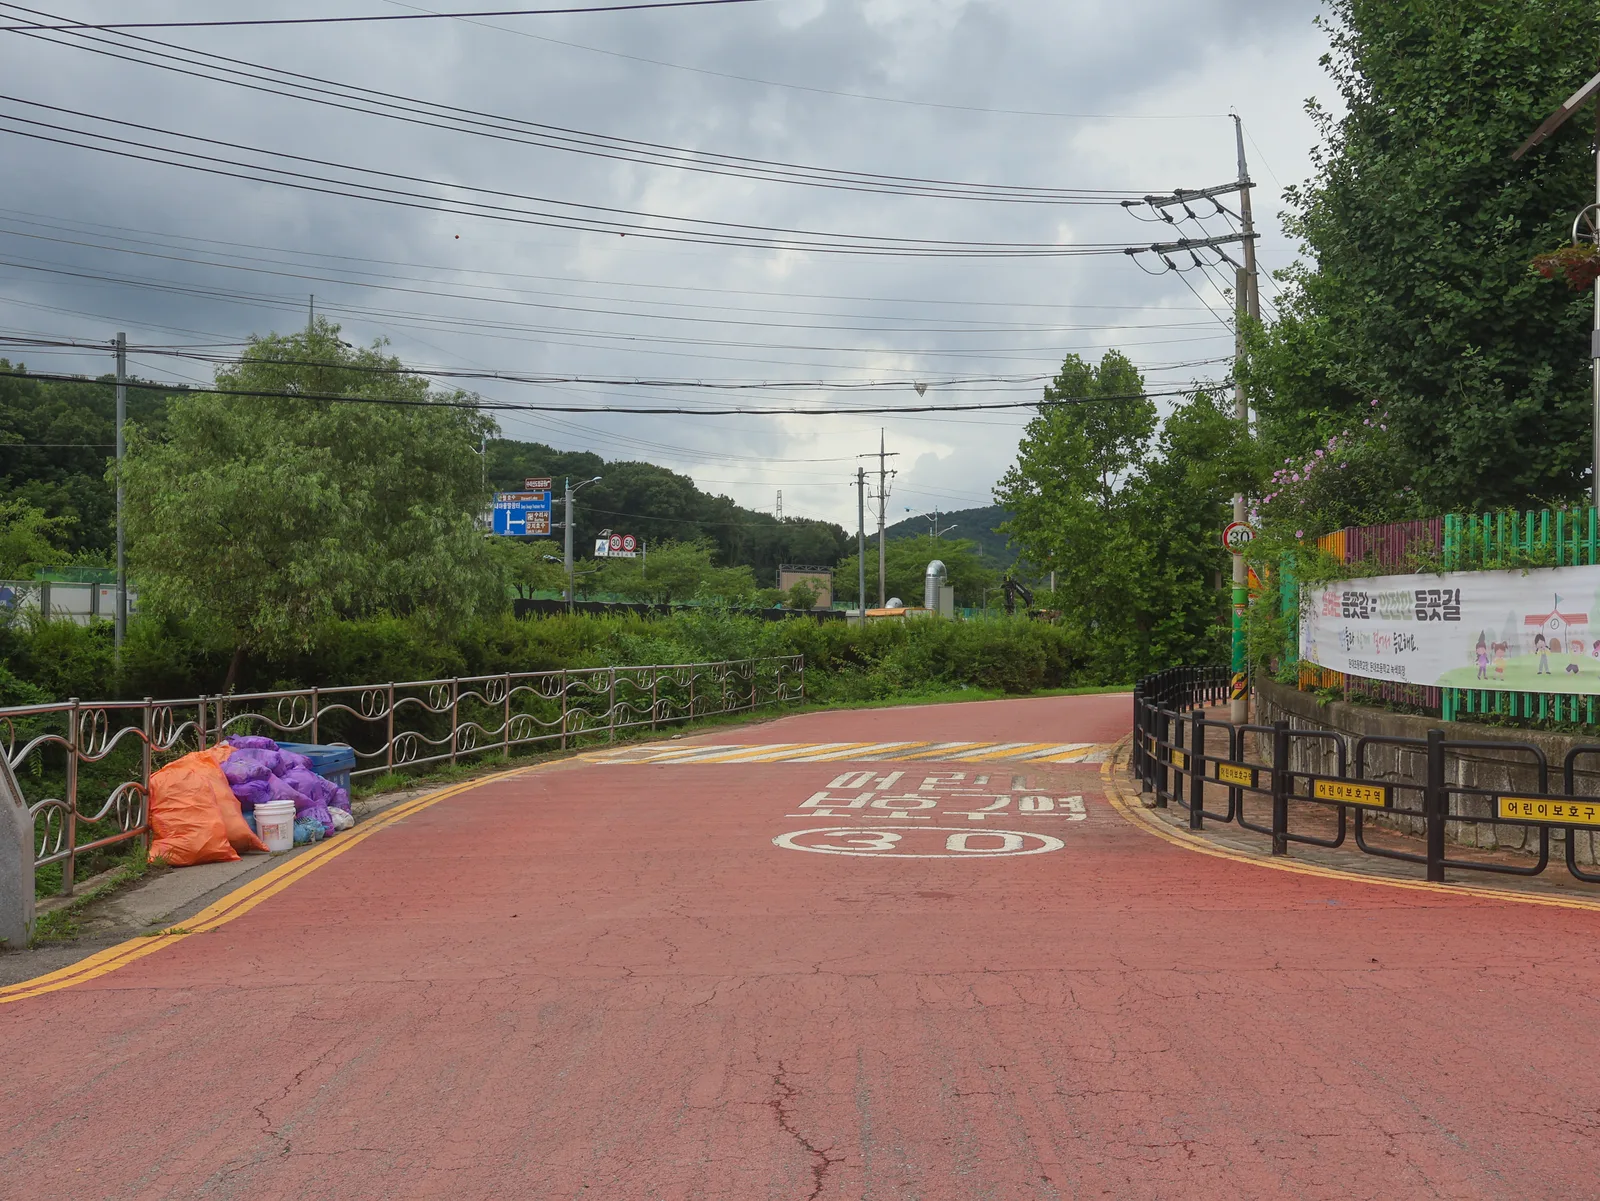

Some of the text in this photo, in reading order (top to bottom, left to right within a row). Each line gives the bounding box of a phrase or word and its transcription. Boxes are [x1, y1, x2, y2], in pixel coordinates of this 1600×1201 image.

[612, 539, 620, 547] 30
[1230, 531, 1249, 544] 30
[1414, 588, 1461, 622] 등굣길
[1373, 629, 1391, 654] 걸어서
[1393, 632, 1419, 654] 등교해요.
[1319, 784, 1380, 802] 어린이보호구역
[784, 792, 1088, 821] 보호구역
[811, 831, 1024, 853] 30
